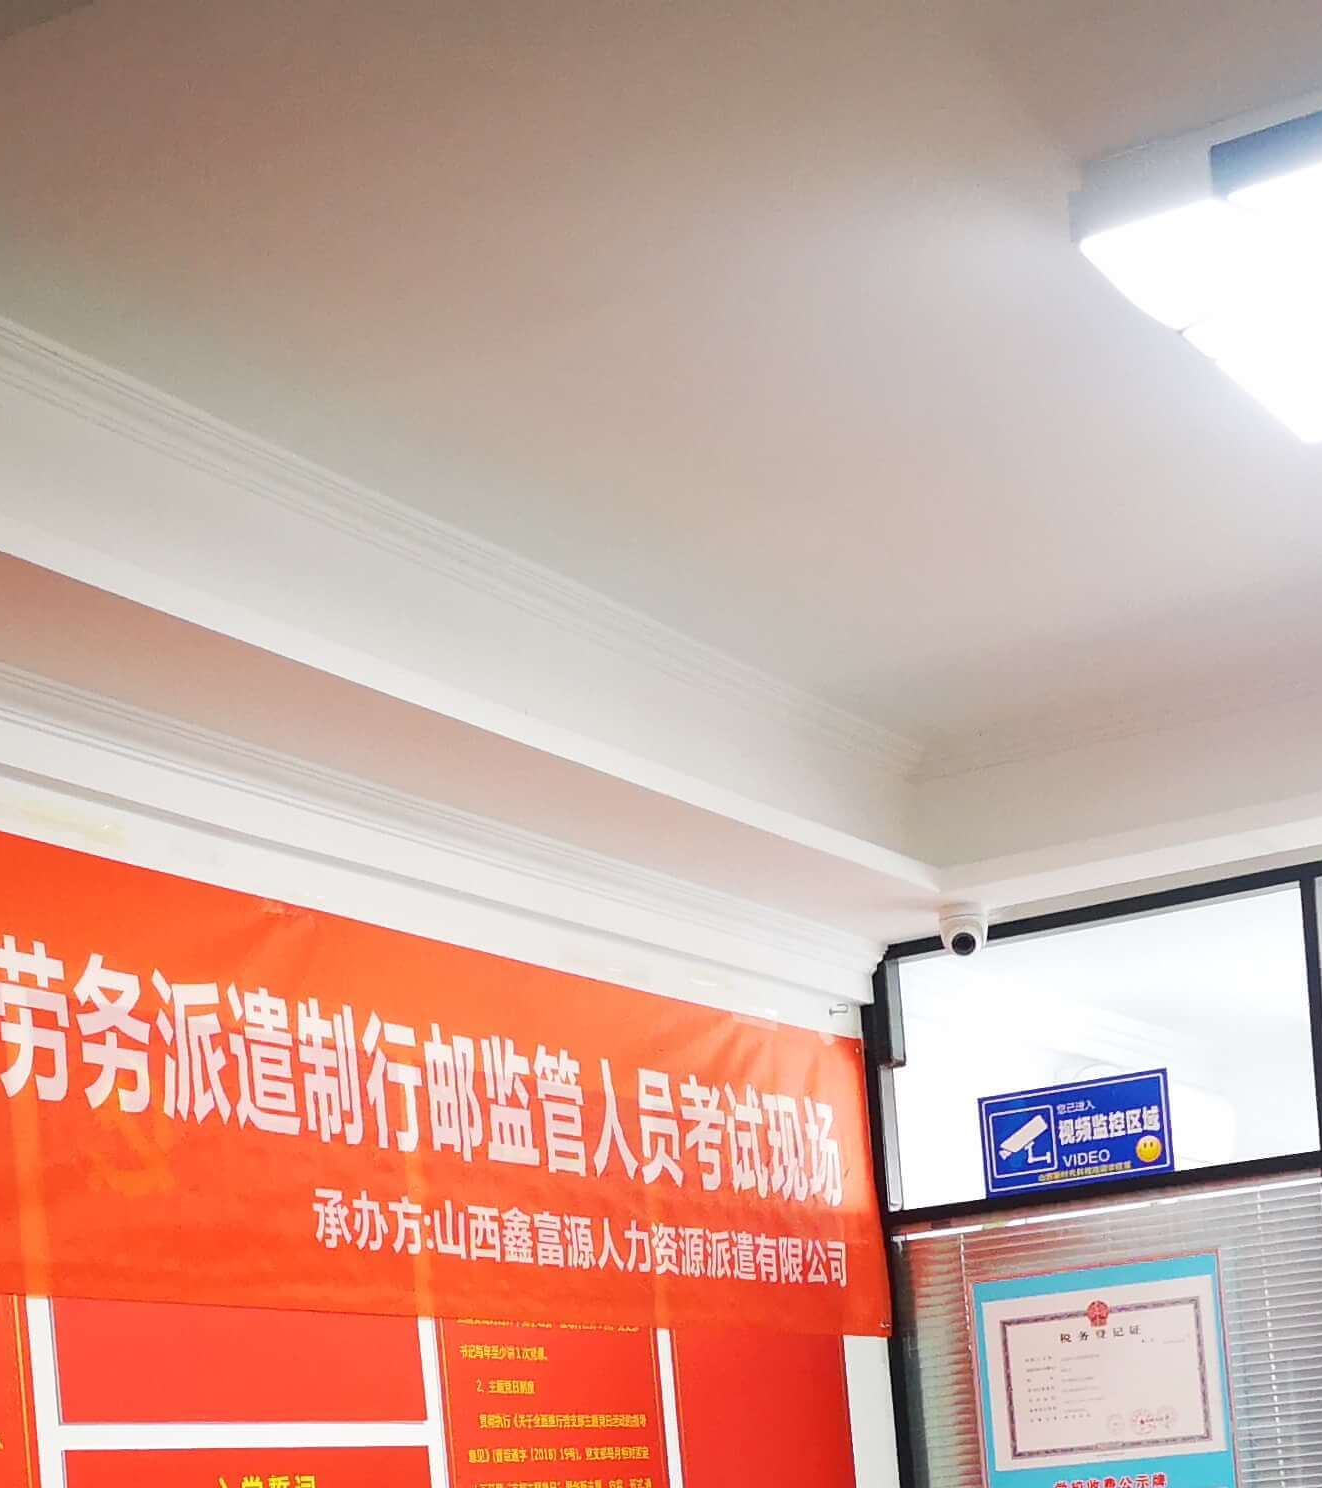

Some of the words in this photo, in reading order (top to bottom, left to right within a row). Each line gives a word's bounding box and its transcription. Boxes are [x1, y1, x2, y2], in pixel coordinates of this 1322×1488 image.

[1059, 1105, 1160, 1145] 视频监控区域
[1062, 1149, 1110, 1167] VIDEO
